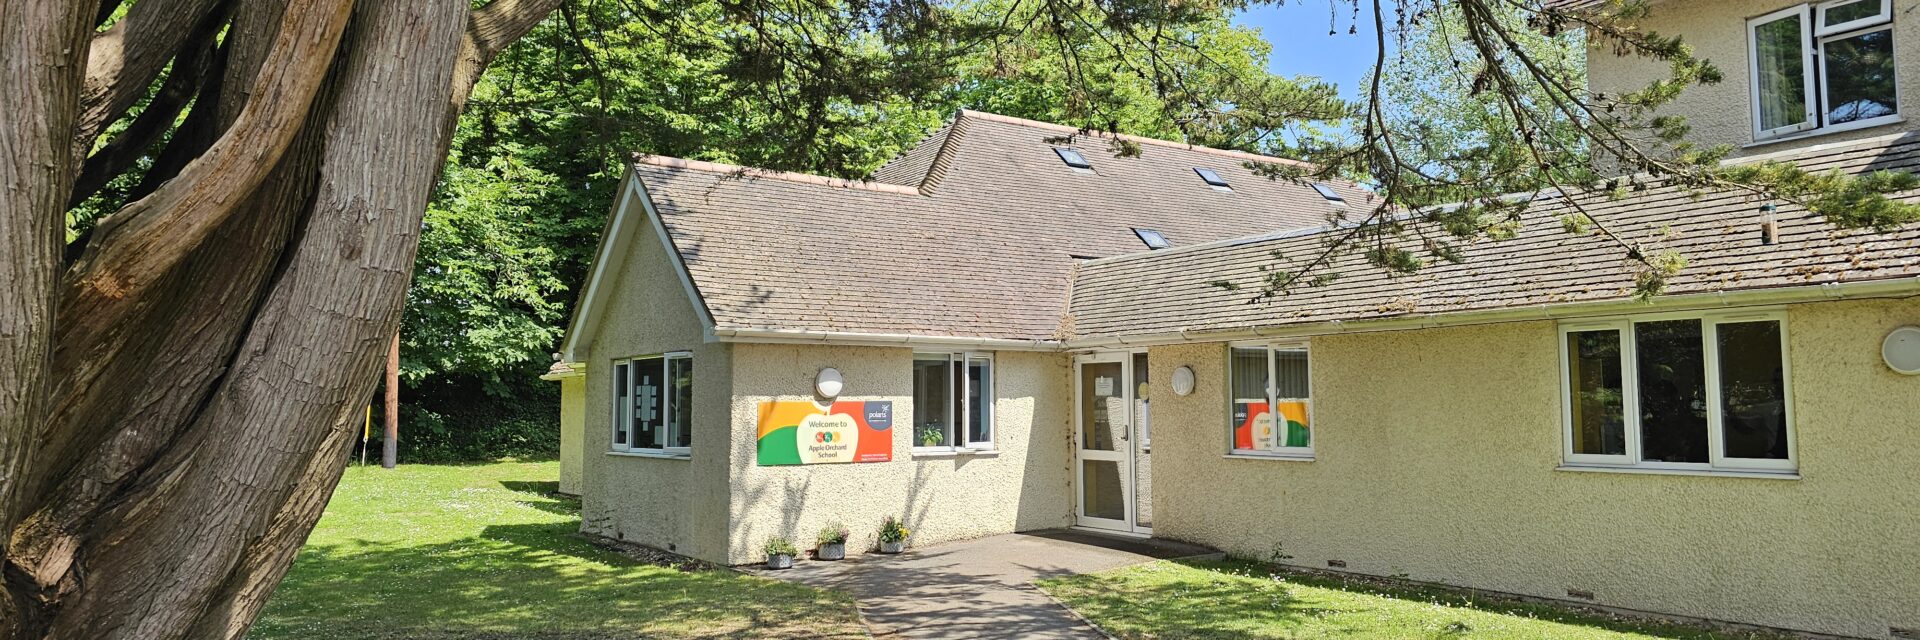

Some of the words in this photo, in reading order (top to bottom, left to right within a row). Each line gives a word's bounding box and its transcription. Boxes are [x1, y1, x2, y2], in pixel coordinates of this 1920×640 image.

[868, 411, 887, 419] polaris
[808, 420, 839, 428] Welcome
[808, 445, 825, 453] Apple
